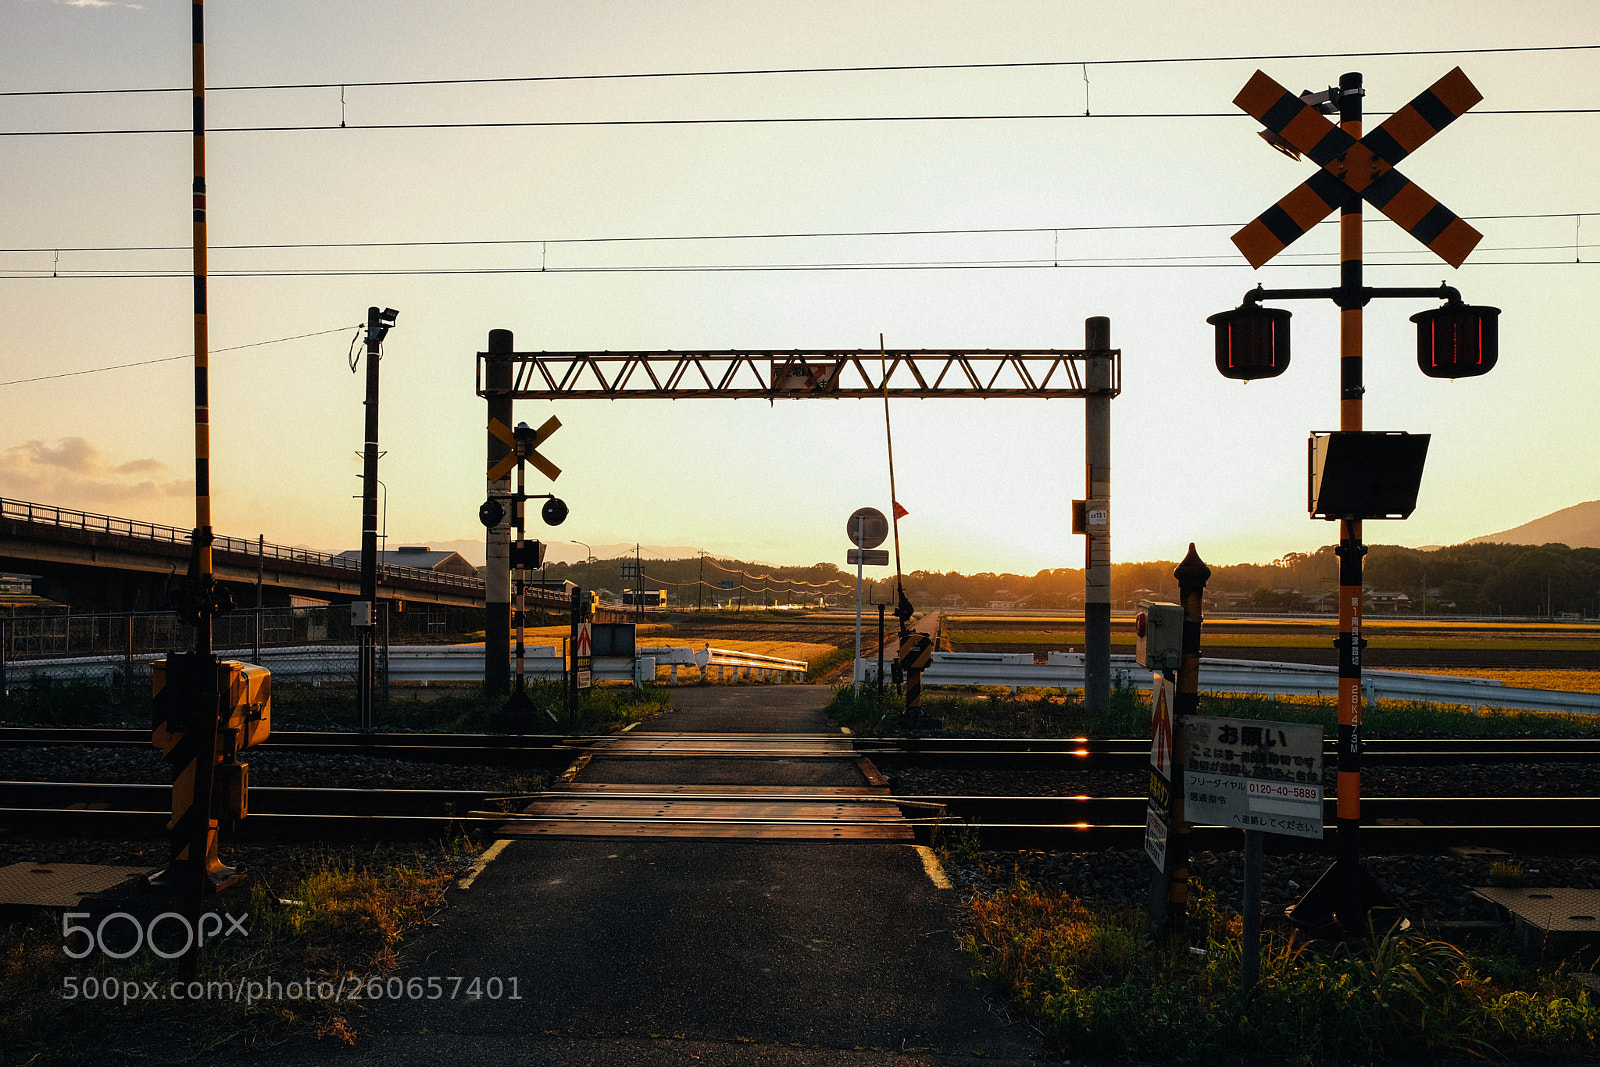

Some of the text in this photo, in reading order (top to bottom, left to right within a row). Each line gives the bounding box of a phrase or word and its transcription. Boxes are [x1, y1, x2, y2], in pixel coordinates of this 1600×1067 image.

[1218, 724, 1288, 746] お願い
[1189, 776, 1317, 799] フリーダイヤル 0120-40-5889
